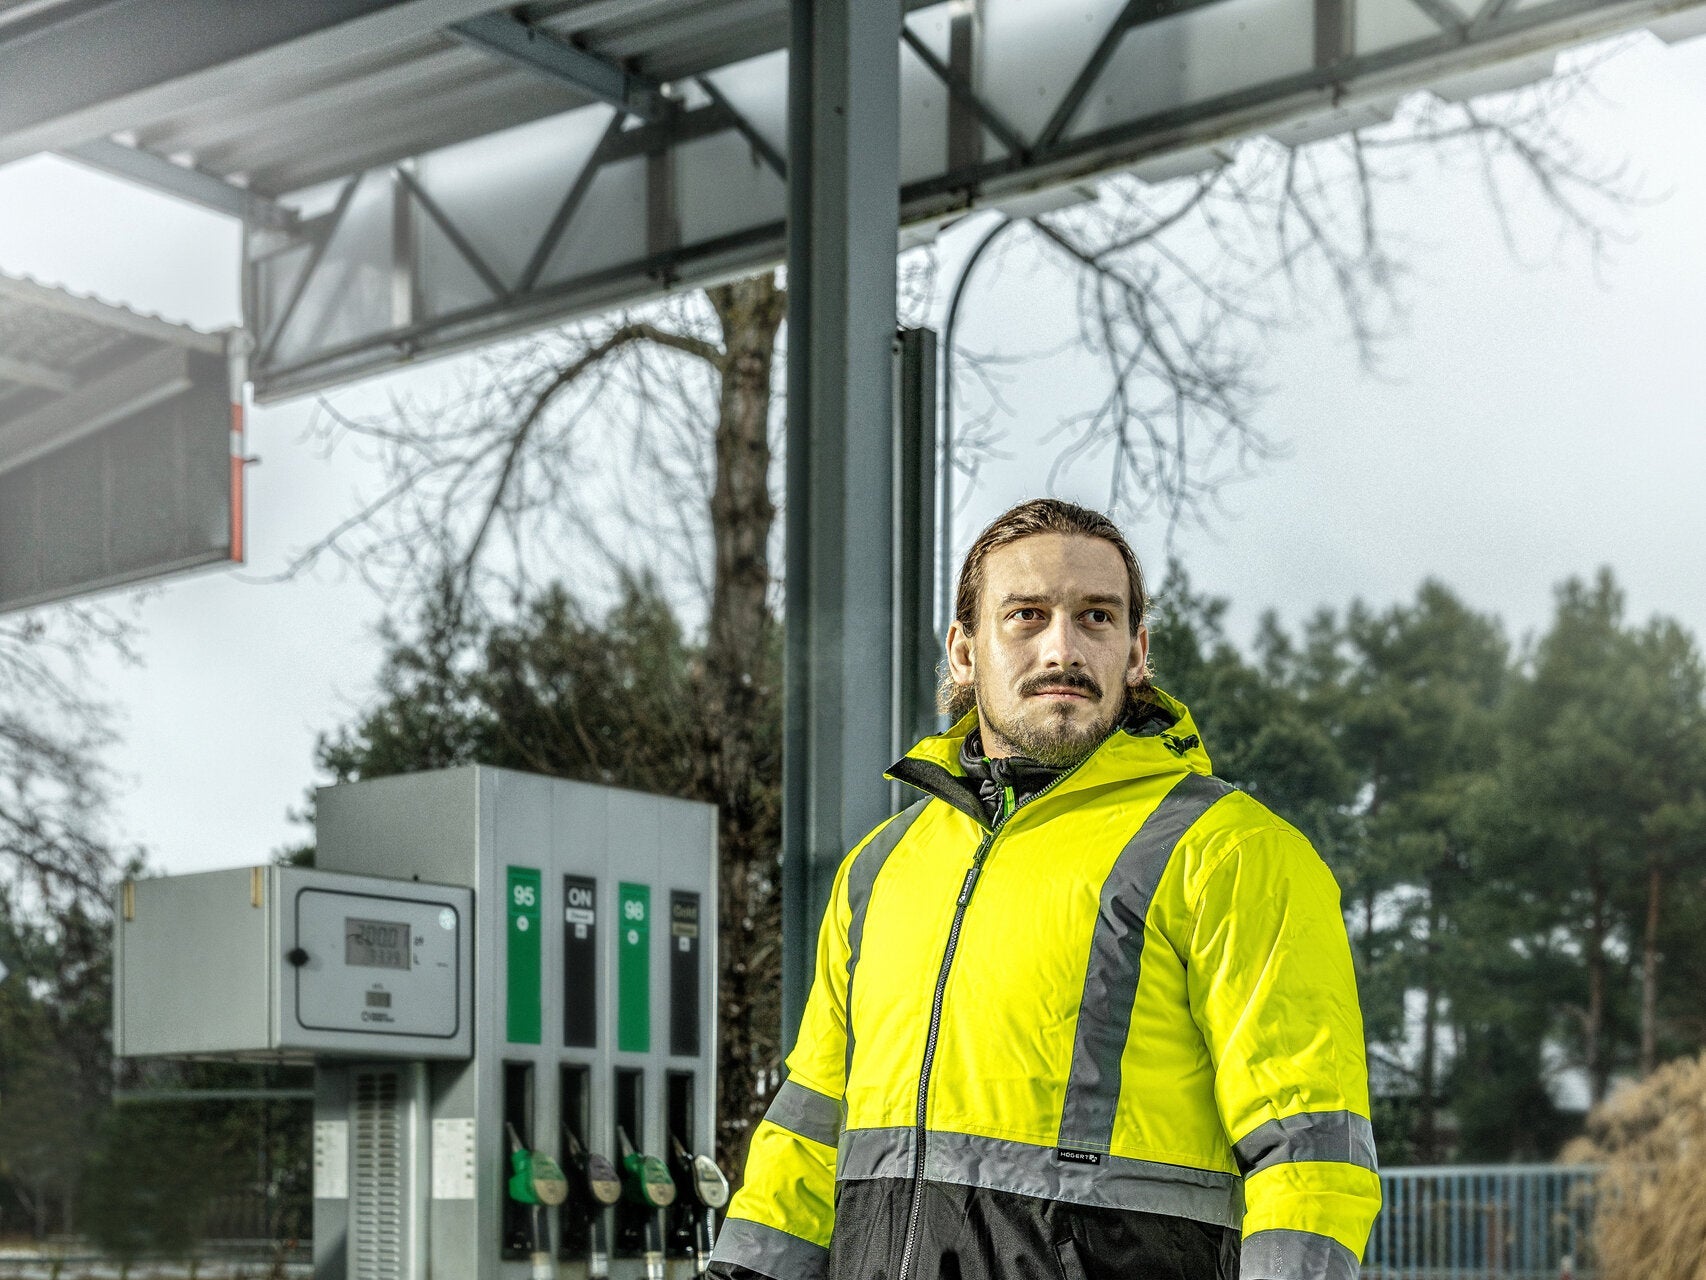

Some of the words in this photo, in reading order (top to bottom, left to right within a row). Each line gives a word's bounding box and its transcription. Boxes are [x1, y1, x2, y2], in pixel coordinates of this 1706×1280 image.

[513, 885, 535, 907] 95
[568, 887, 592, 907] ON
[624, 900, 644, 921] 98
